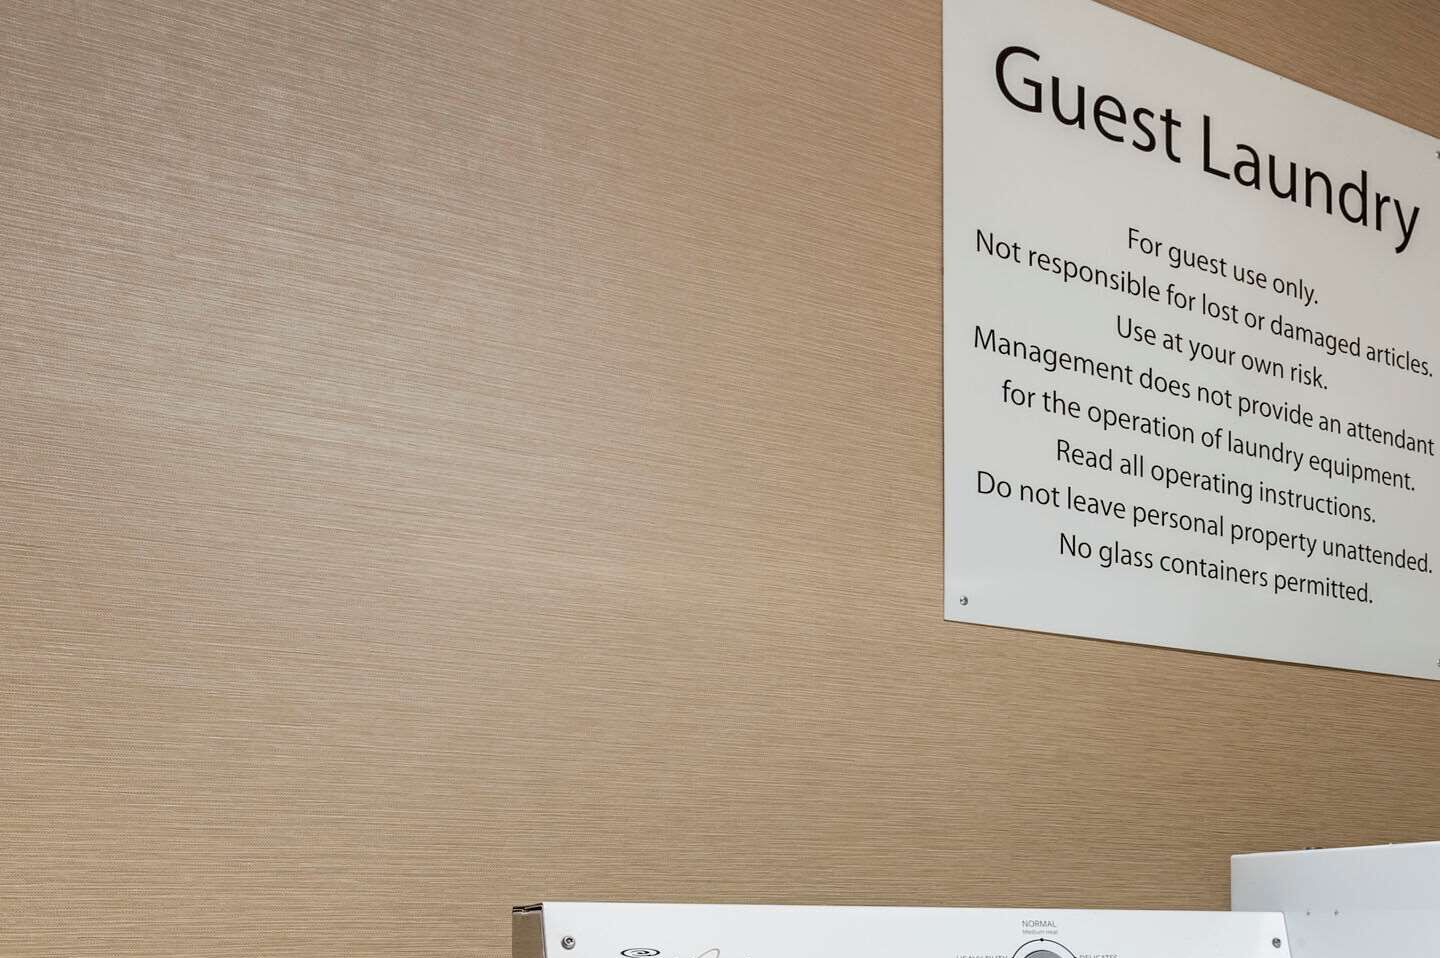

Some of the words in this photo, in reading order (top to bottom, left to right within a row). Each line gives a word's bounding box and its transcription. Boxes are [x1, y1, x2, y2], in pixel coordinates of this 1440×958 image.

[995, 45, 1182, 164] Guest
[1203, 114, 1421, 255] Laundry
[976, 228, 1022, 264] Not
[1028, 250, 1161, 302] responsible
[1166, 283, 1196, 312] for
[1202, 292, 1239, 325] lost
[1244, 312, 1265, 331] or
[1270, 314, 1361, 358] damaged
[1366, 345, 1433, 377] articles.
[1128, 227, 1163, 257] For
[1168, 246, 1227, 278] guest
[1233, 265, 1268, 289] use
[1272, 278, 1318, 307] only.
[974, 325, 1133, 386] Management
[1139, 367, 1191, 399] does
[1197, 386, 1233, 409] not
[1238, 396, 1314, 428] provide
[1318, 415, 1341, 435] an
[1346, 422, 1435, 457] attendant
[1117, 315, 1157, 346] Use
[1162, 333, 1183, 353] at
[1188, 339, 1236, 366] your
[1241, 354, 1284, 379] own
[1290, 365, 1328, 390] risk.
[1001, 379, 1036, 408] for
[1042, 390, 1081, 419] the
[1087, 406, 1194, 444] operation
[1201, 427, 1224, 449] of
[1228, 430, 1304, 472] laundry
[1309, 455, 1416, 491] equipment.
[1057, 438, 1113, 472] Read
[1119, 453, 1144, 478] all
[1150, 464, 1253, 505] operating
[1259, 481, 1376, 523] instructions.
[977, 470, 1012, 498] Do
[1020, 484, 1061, 508] not
[1067, 486, 1126, 519] leave
[1133, 505, 1224, 537] personal
[1231, 523, 1317, 558] property
[1323, 540, 1432, 574] unattended.
[1060, 532, 1092, 559] No
[1099, 540, 1153, 569] glass
[1159, 555, 1268, 587] containers
[1274, 574, 1373, 604] permitted.
[1021, 919, 1057, 928] NORMAL
